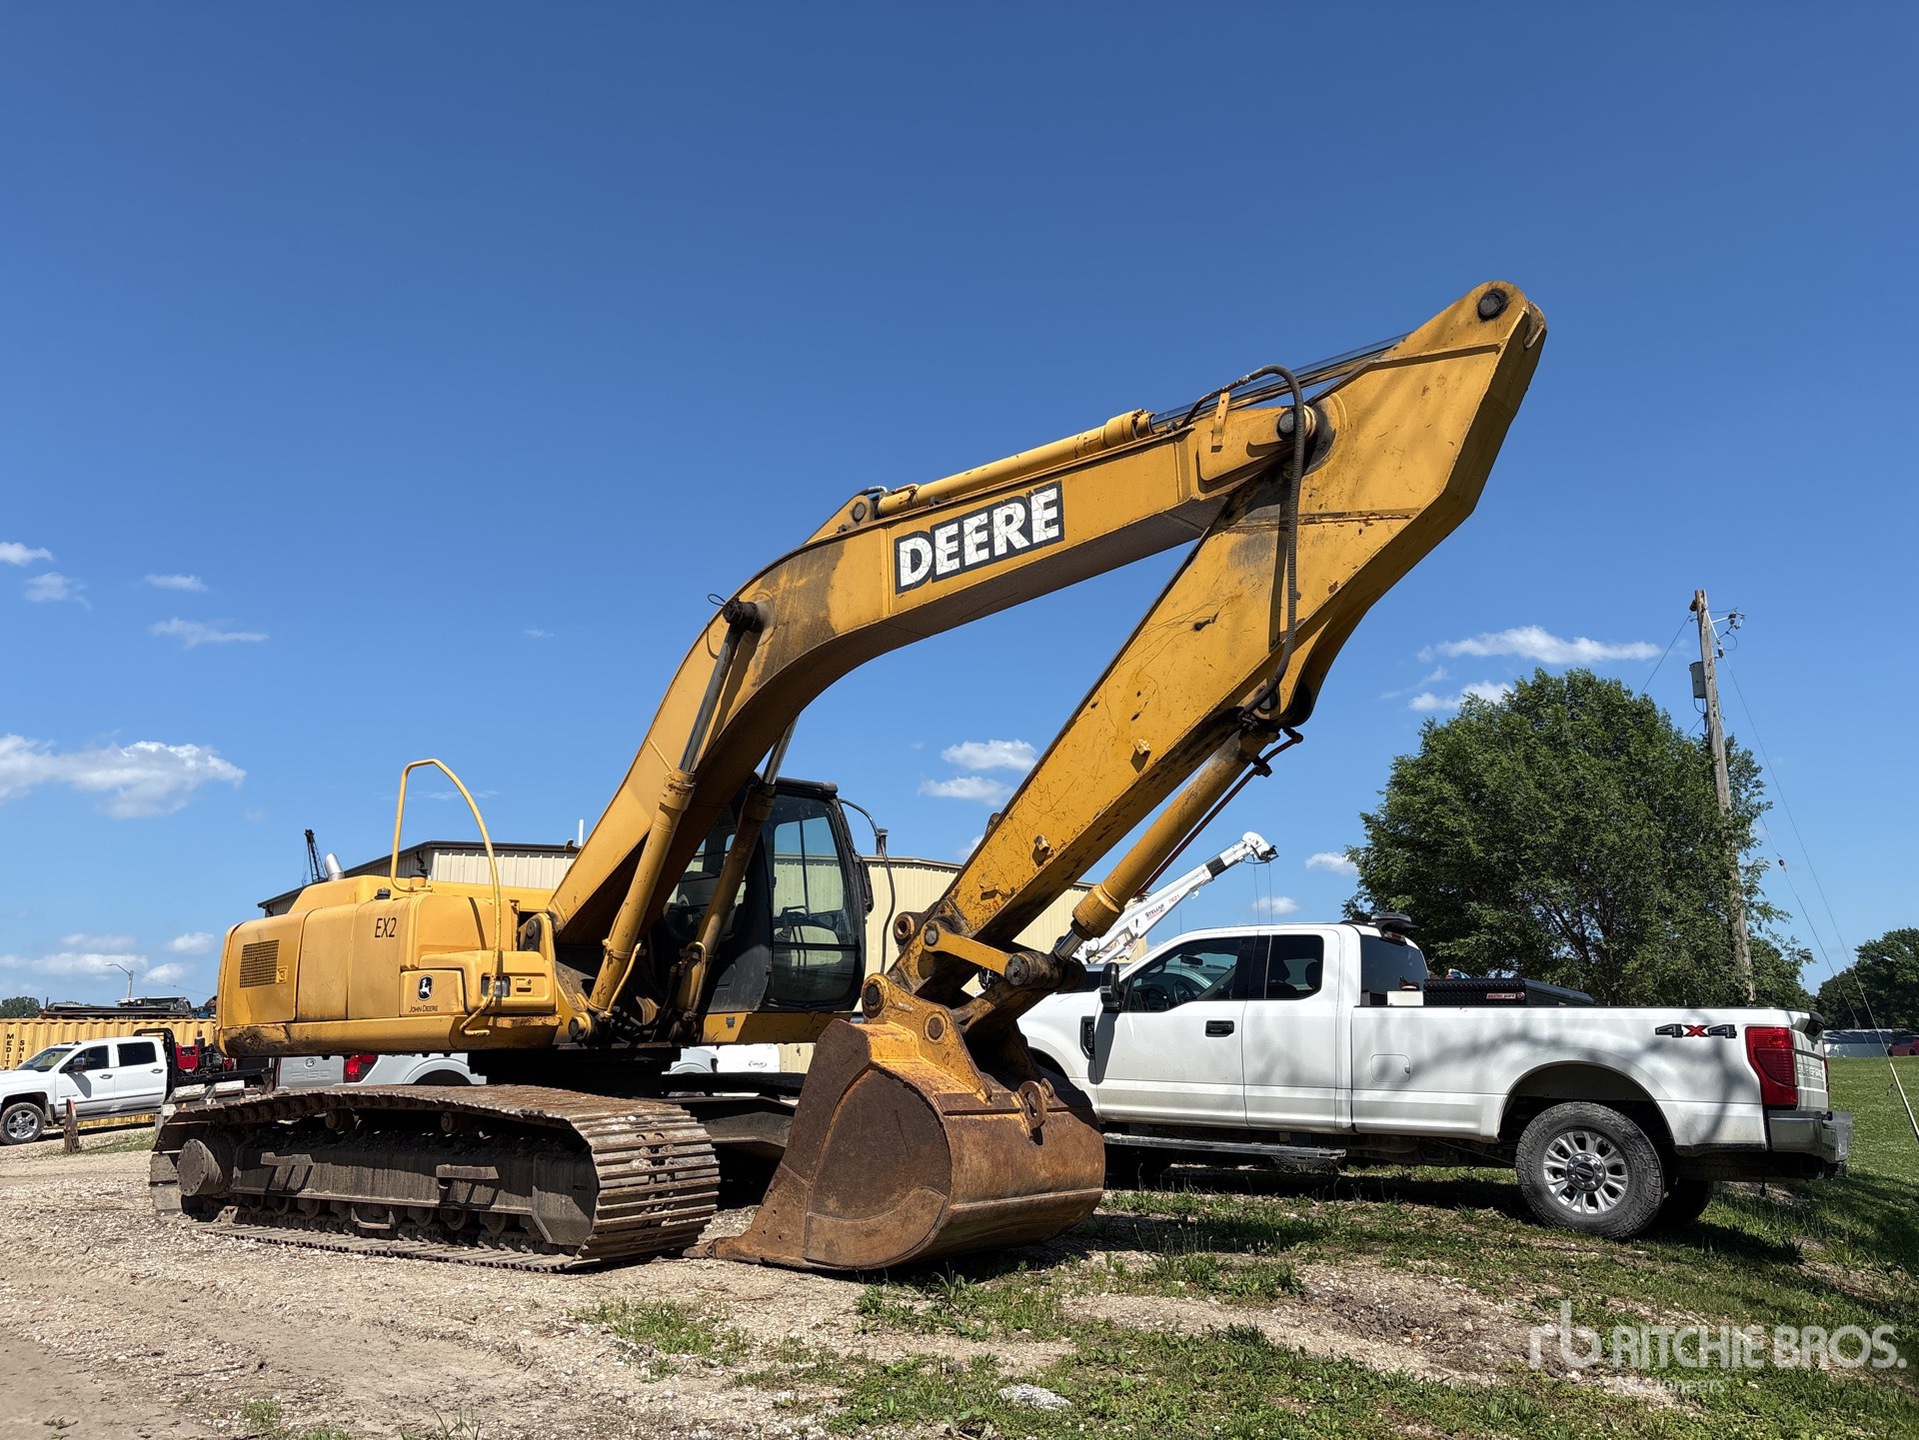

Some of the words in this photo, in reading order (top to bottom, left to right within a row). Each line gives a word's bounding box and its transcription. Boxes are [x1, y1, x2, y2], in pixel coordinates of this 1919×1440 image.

[899, 487, 1060, 587] DEERE
[374, 917, 397, 938] EX2
[409, 1005, 422, 1013] JOHN
